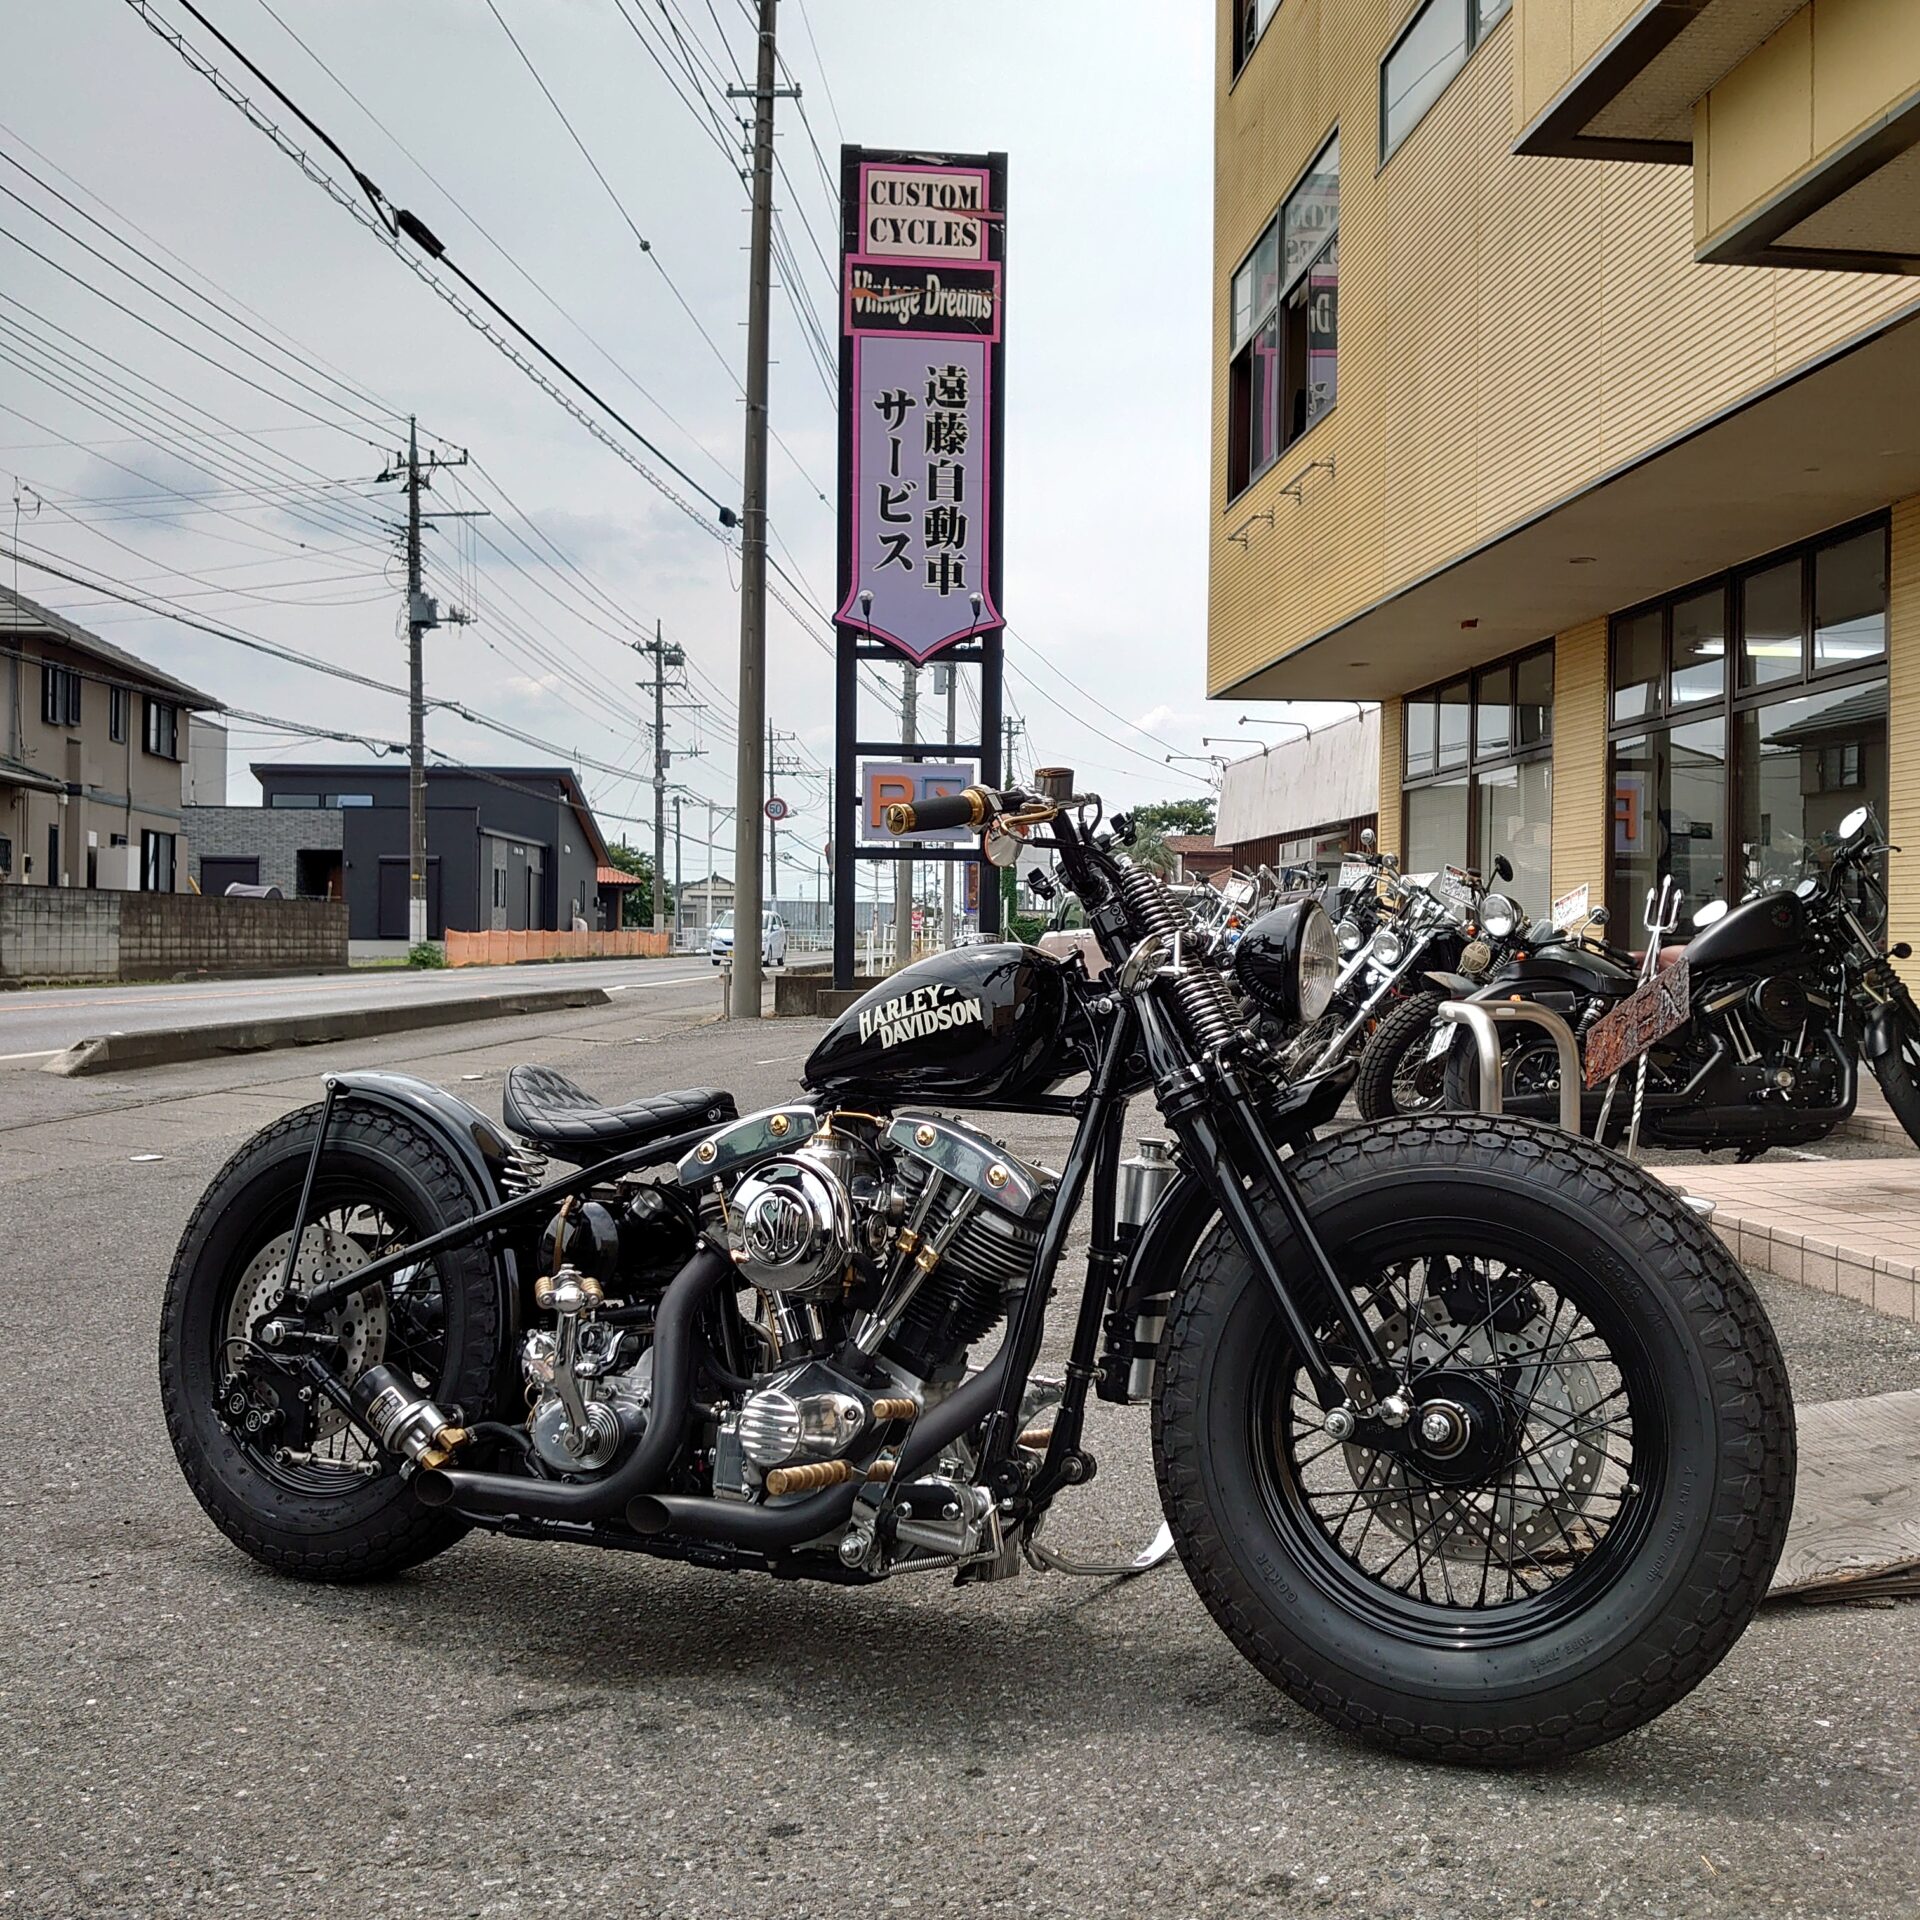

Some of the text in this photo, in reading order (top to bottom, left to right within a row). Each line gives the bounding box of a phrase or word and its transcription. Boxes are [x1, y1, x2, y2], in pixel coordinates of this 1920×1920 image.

[870, 180, 978, 210] CUSTOM
[870, 217, 978, 247] CYCLES
[853, 270, 993, 325] Vintage Dreams
[873, 389, 917, 572] サービス
[924, 364, 969, 597] 遠藤自動車
[768, 802, 783, 815] 50
[880, 997, 983, 1050] DAVIDSON
[1256, 1553, 1297, 1602] COKER
